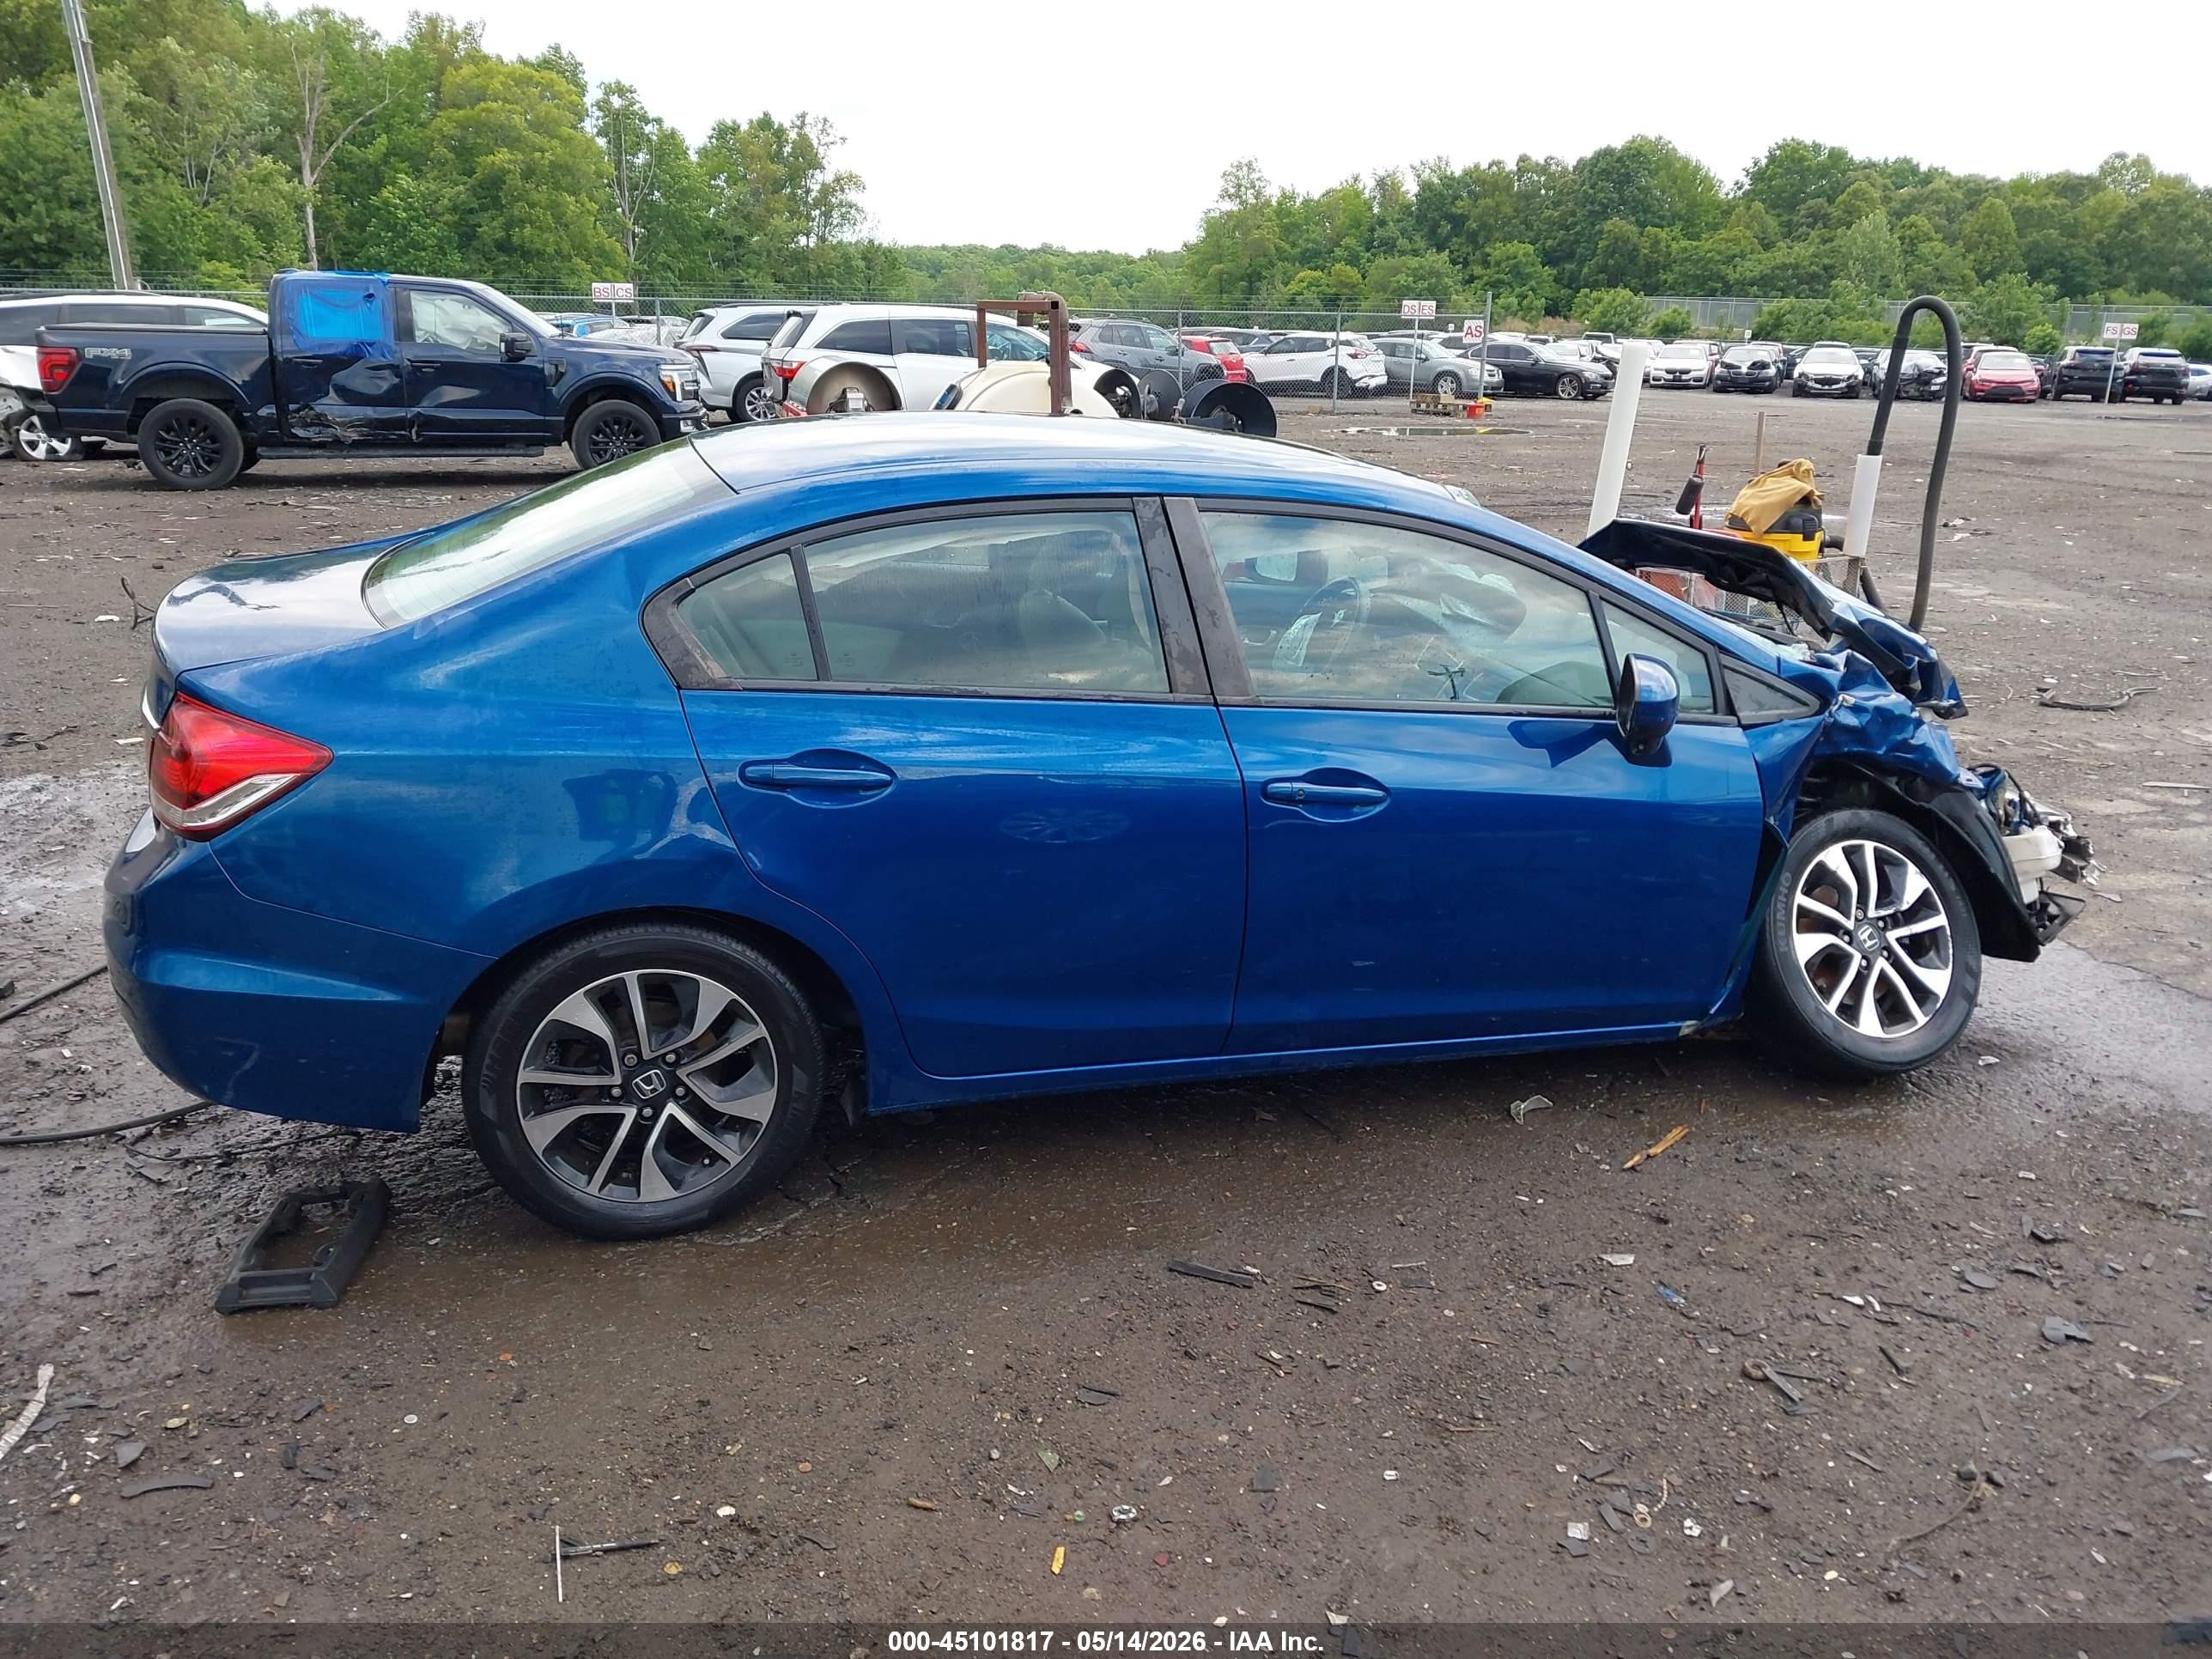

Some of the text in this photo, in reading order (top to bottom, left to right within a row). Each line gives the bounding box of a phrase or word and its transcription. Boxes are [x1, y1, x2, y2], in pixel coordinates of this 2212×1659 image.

[593, 287, 632, 298] BS CS
[1402, 304, 1434, 315] DS ES
[1464, 325, 1483, 338] AS
[2106, 326, 2137, 336] FS GS
[84, 347, 131, 360] FX4
[1776, 872, 1793, 952] KUMHO
